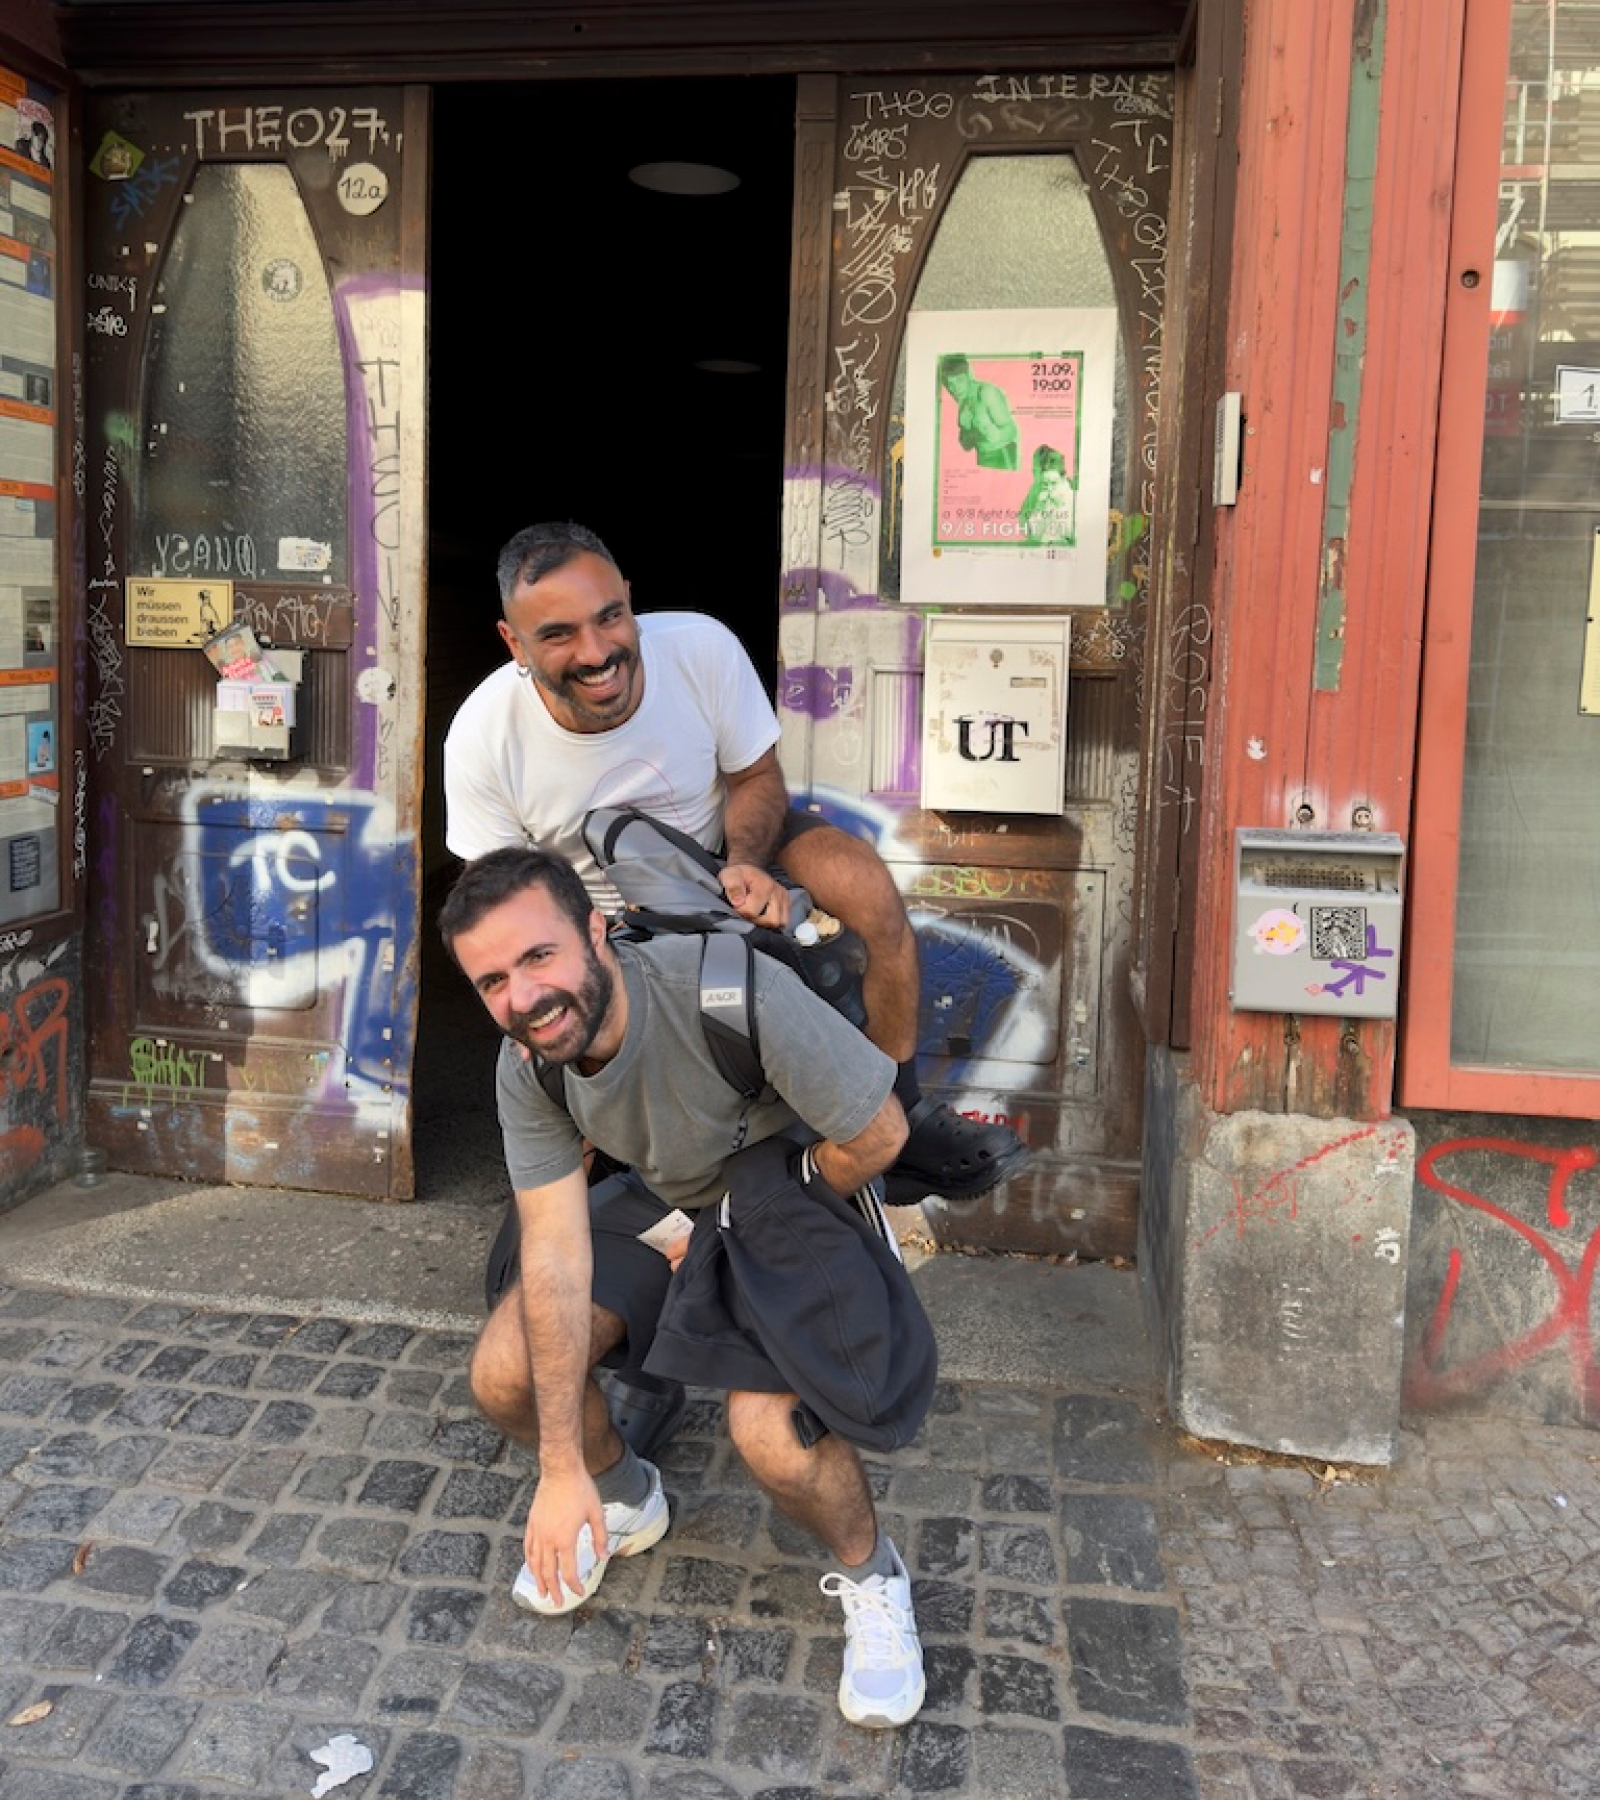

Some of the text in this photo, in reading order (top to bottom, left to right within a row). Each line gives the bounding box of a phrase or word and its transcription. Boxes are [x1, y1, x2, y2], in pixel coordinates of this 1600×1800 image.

[337, 175, 383, 200] 12a
[1031, 363, 1075, 376] 21.09.
[1033, 379, 1072, 391] 19:00
[941, 522, 976, 538] 9/8
[982, 522, 1038, 537] FIGHT
[136, 586, 156, 597] Wir
[136, 599, 182, 612] müssen
[136, 613, 189, 625] draussen
[136, 625, 178, 638] bleiben
[952, 718, 1030, 762] UT
[229, 831, 337, 891] TC
